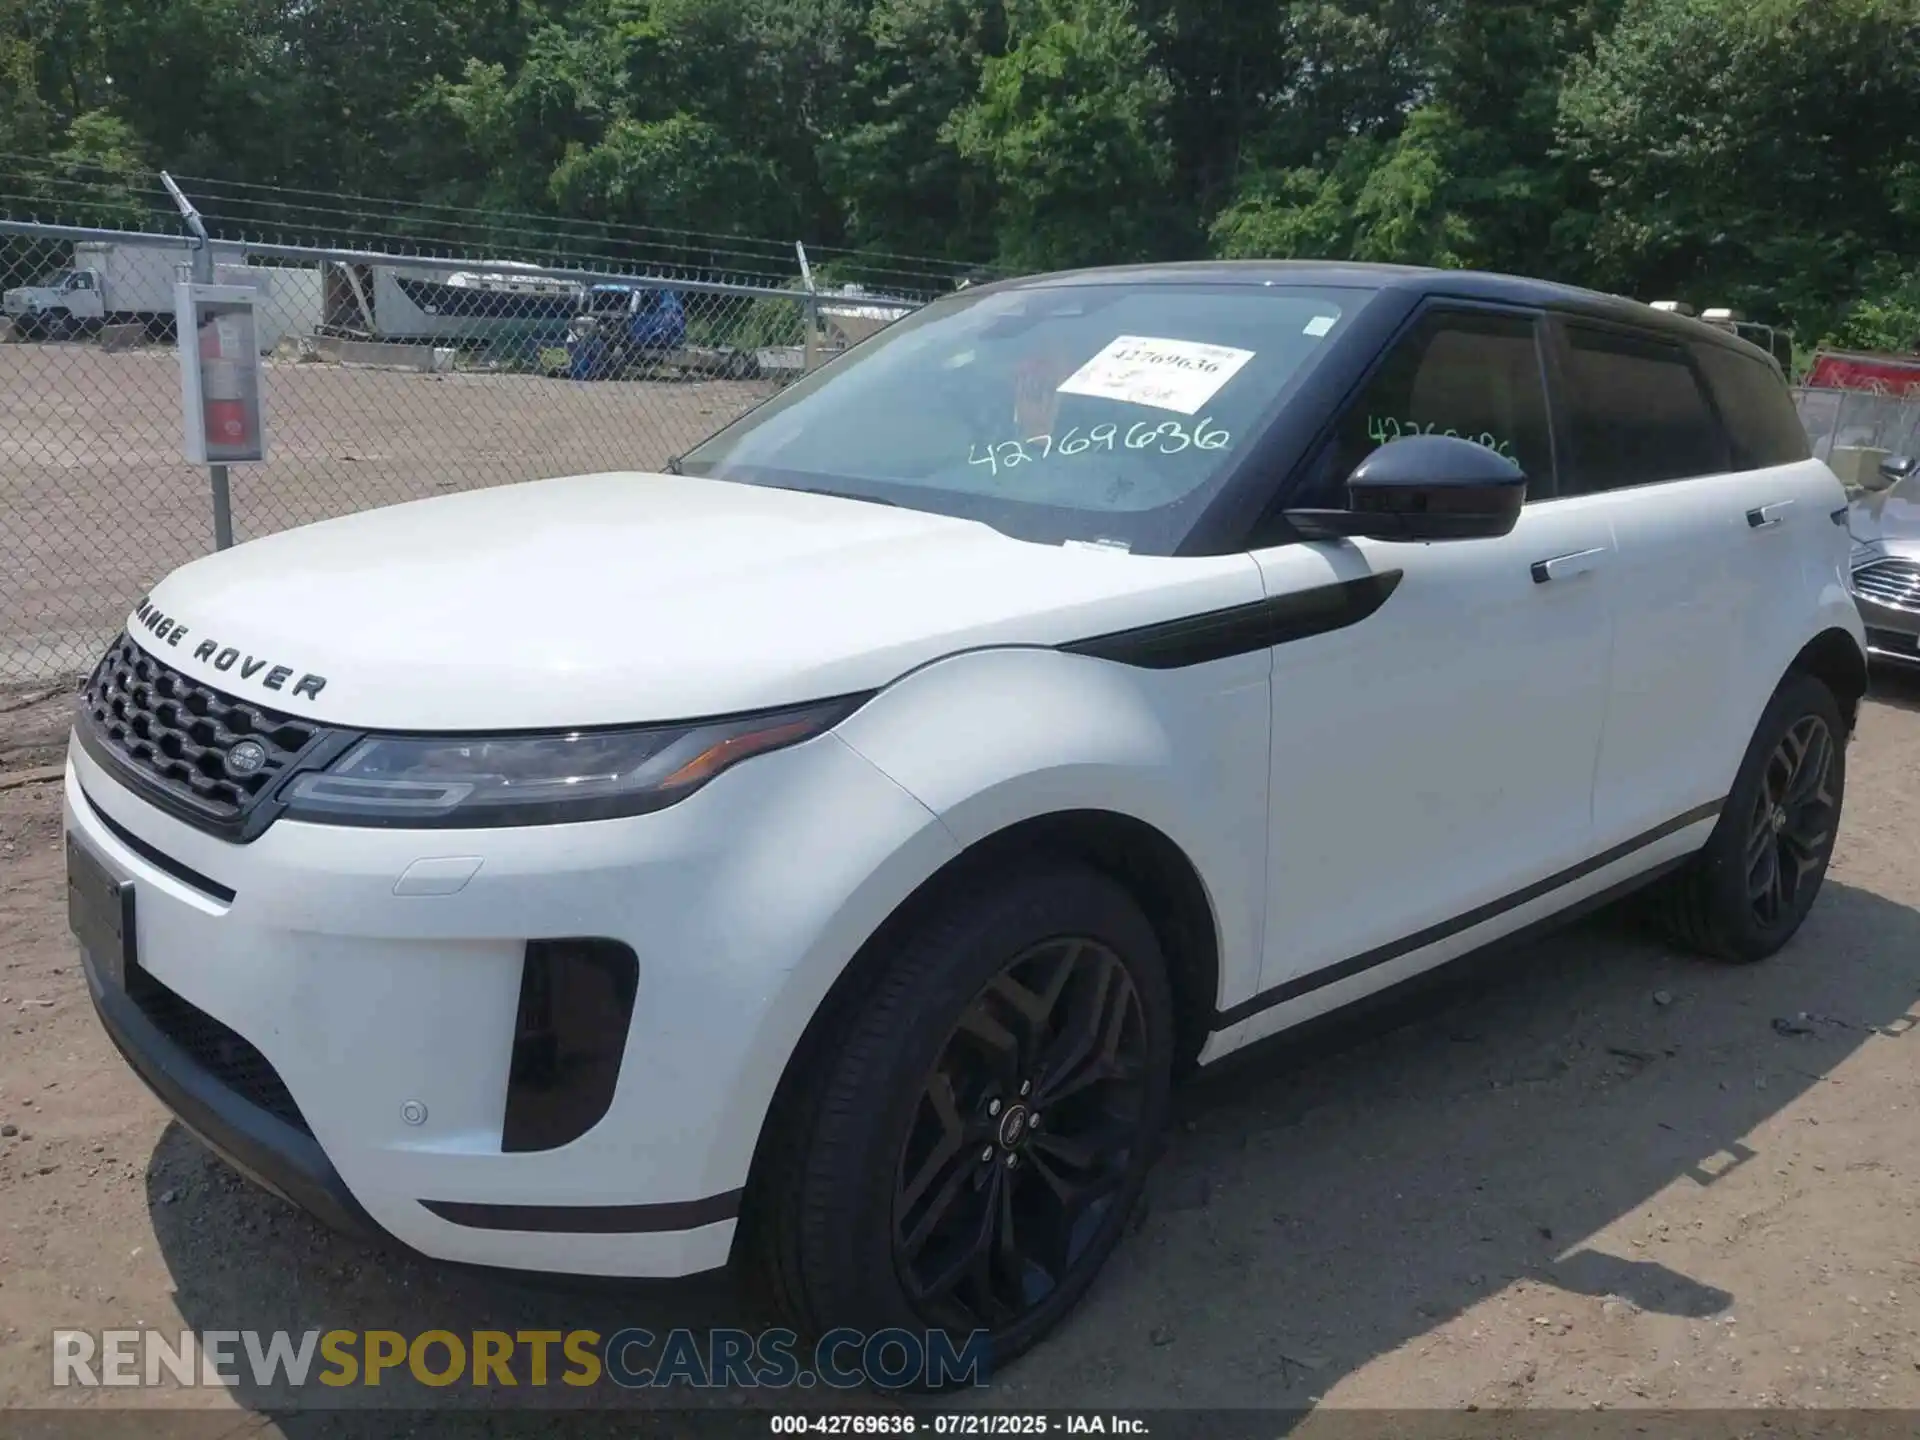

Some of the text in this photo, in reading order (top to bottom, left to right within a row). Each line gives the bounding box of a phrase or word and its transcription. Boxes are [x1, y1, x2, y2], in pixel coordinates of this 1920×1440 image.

[1111, 348, 1220, 373] 42769636
[968, 416, 1230, 476] 42769636
[193, 638, 327, 701] ROVER
